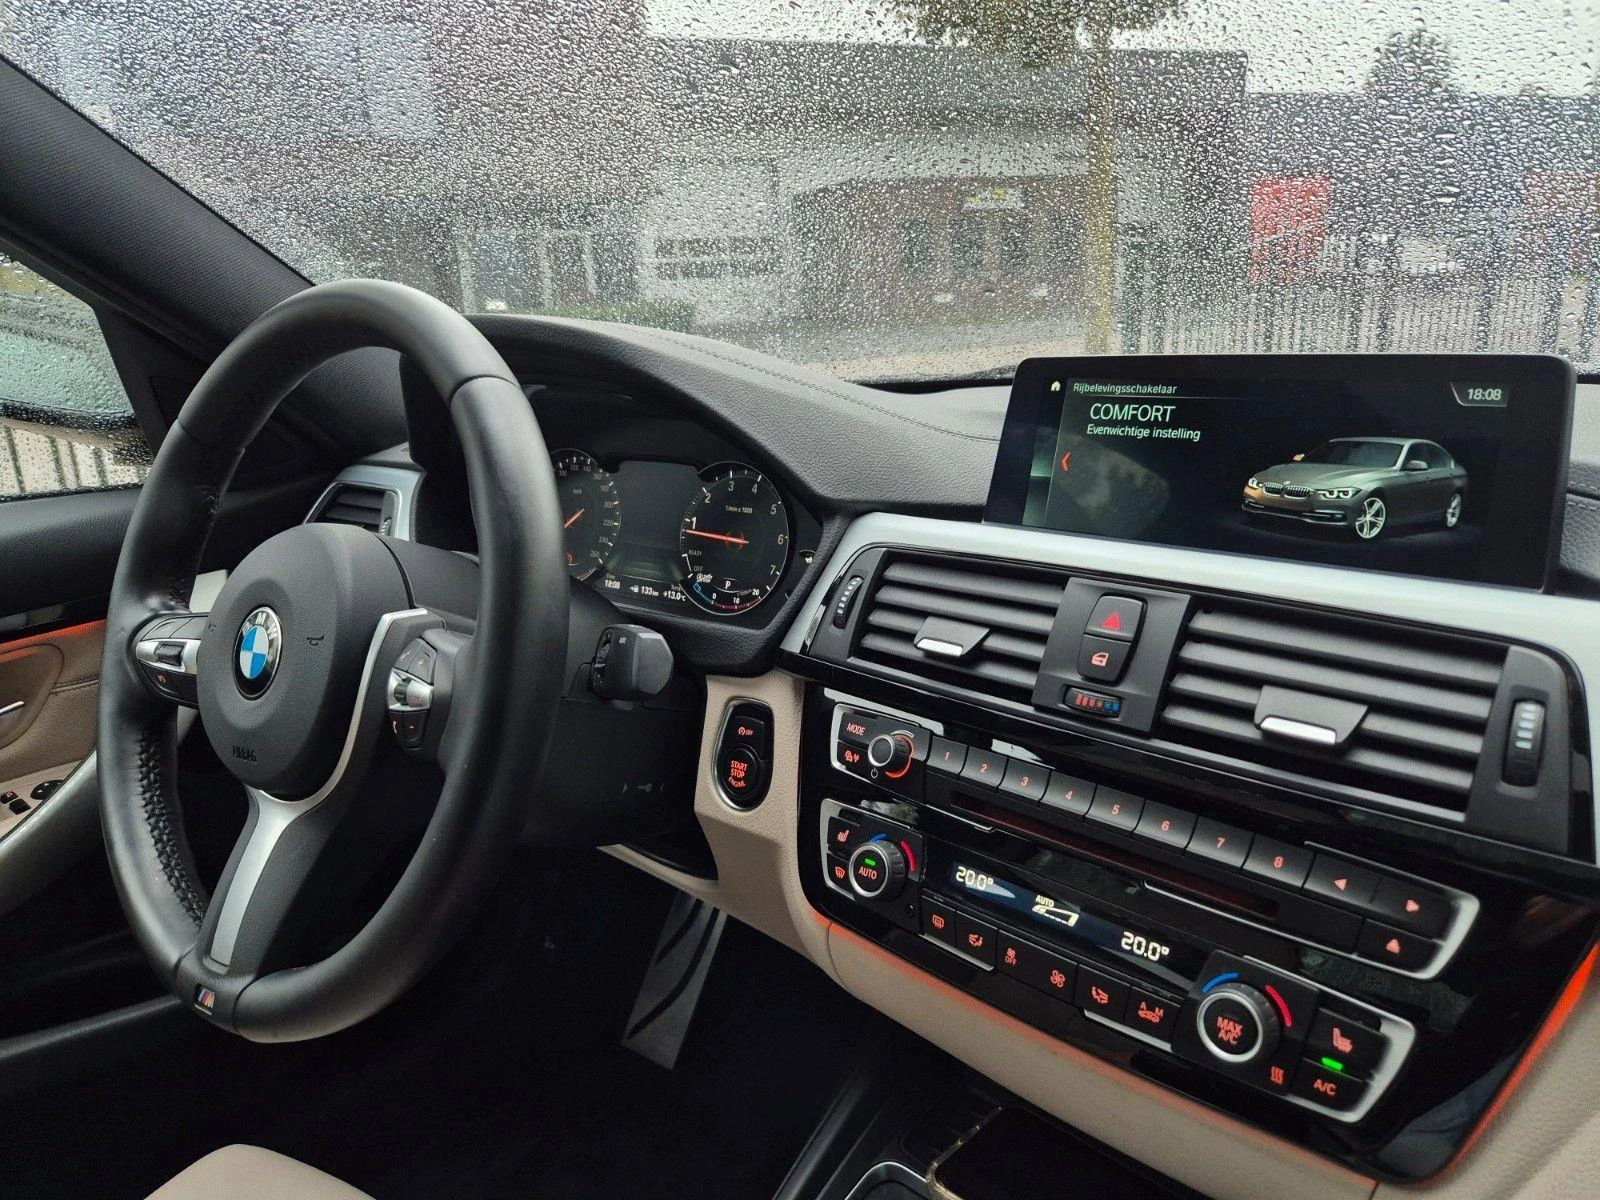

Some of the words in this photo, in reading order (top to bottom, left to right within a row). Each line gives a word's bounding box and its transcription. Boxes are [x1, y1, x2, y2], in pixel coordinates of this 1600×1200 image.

[1073, 382, 1177, 394] Rijbelevingsschakelaar
[1467, 388, 1502, 401] 18:08
[1089, 403, 1176, 422] COMFORT
[1086, 423, 1150, 439] Evenwichtige
[1152, 427, 1201, 442] instelling
[728, 480, 735, 492] 3
[751, 483, 759, 495] 4
[704, 492, 712, 504] 2
[770, 503, 778, 515] 5
[691, 516, 697, 530] 1
[777, 533, 784, 545] 6
[770, 564, 777, 576] 7
[725, 580, 732, 590] P
[712, 592, 718, 600] 0
[751, 588, 760, 596] 20
[846, 722, 866, 736] MODE
[944, 751, 951, 762] 1
[730, 760, 748, 771] START
[980, 763, 989, 774] 2
[730, 769, 745, 778] STOP
[1020, 775, 1029, 787] 3
[1064, 790, 1074, 801] 4
[1111, 804, 1120, 816] 5
[1160, 820, 1170, 832] 6
[1216, 836, 1226, 849] 7
[1273, 855, 1284, 869] 8
[858, 866, 878, 880] AUTO
[1004, 955, 1017, 966] OFF
[1139, 1001, 1147, 1010] A
[1154, 1006, 1164, 1017] M
[1216, 1016, 1243, 1038] MAX
[1313, 1078, 1337, 1096] A/C
